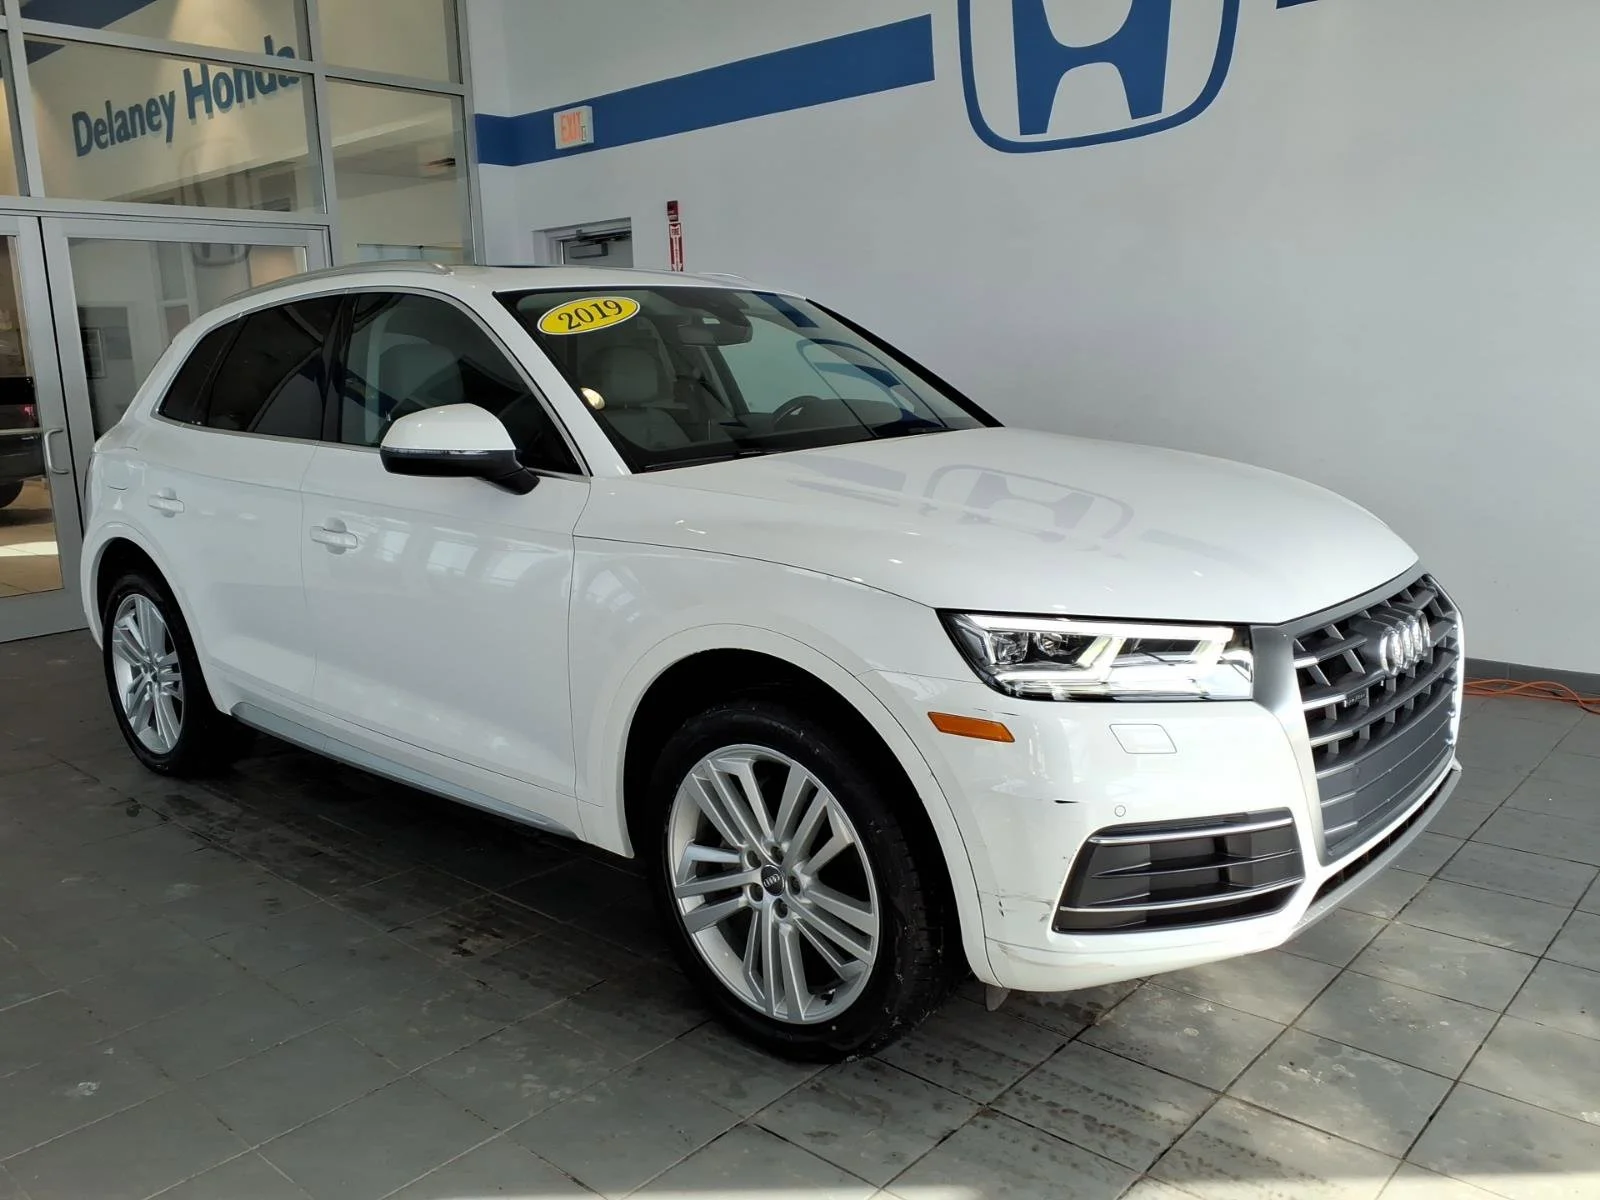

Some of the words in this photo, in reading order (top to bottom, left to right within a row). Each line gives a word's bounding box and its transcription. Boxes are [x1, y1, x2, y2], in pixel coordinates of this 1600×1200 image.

[72, 90, 175, 157] Delaney
[560, 112, 581, 144] EXIT
[557, 299, 623, 330] 2019
